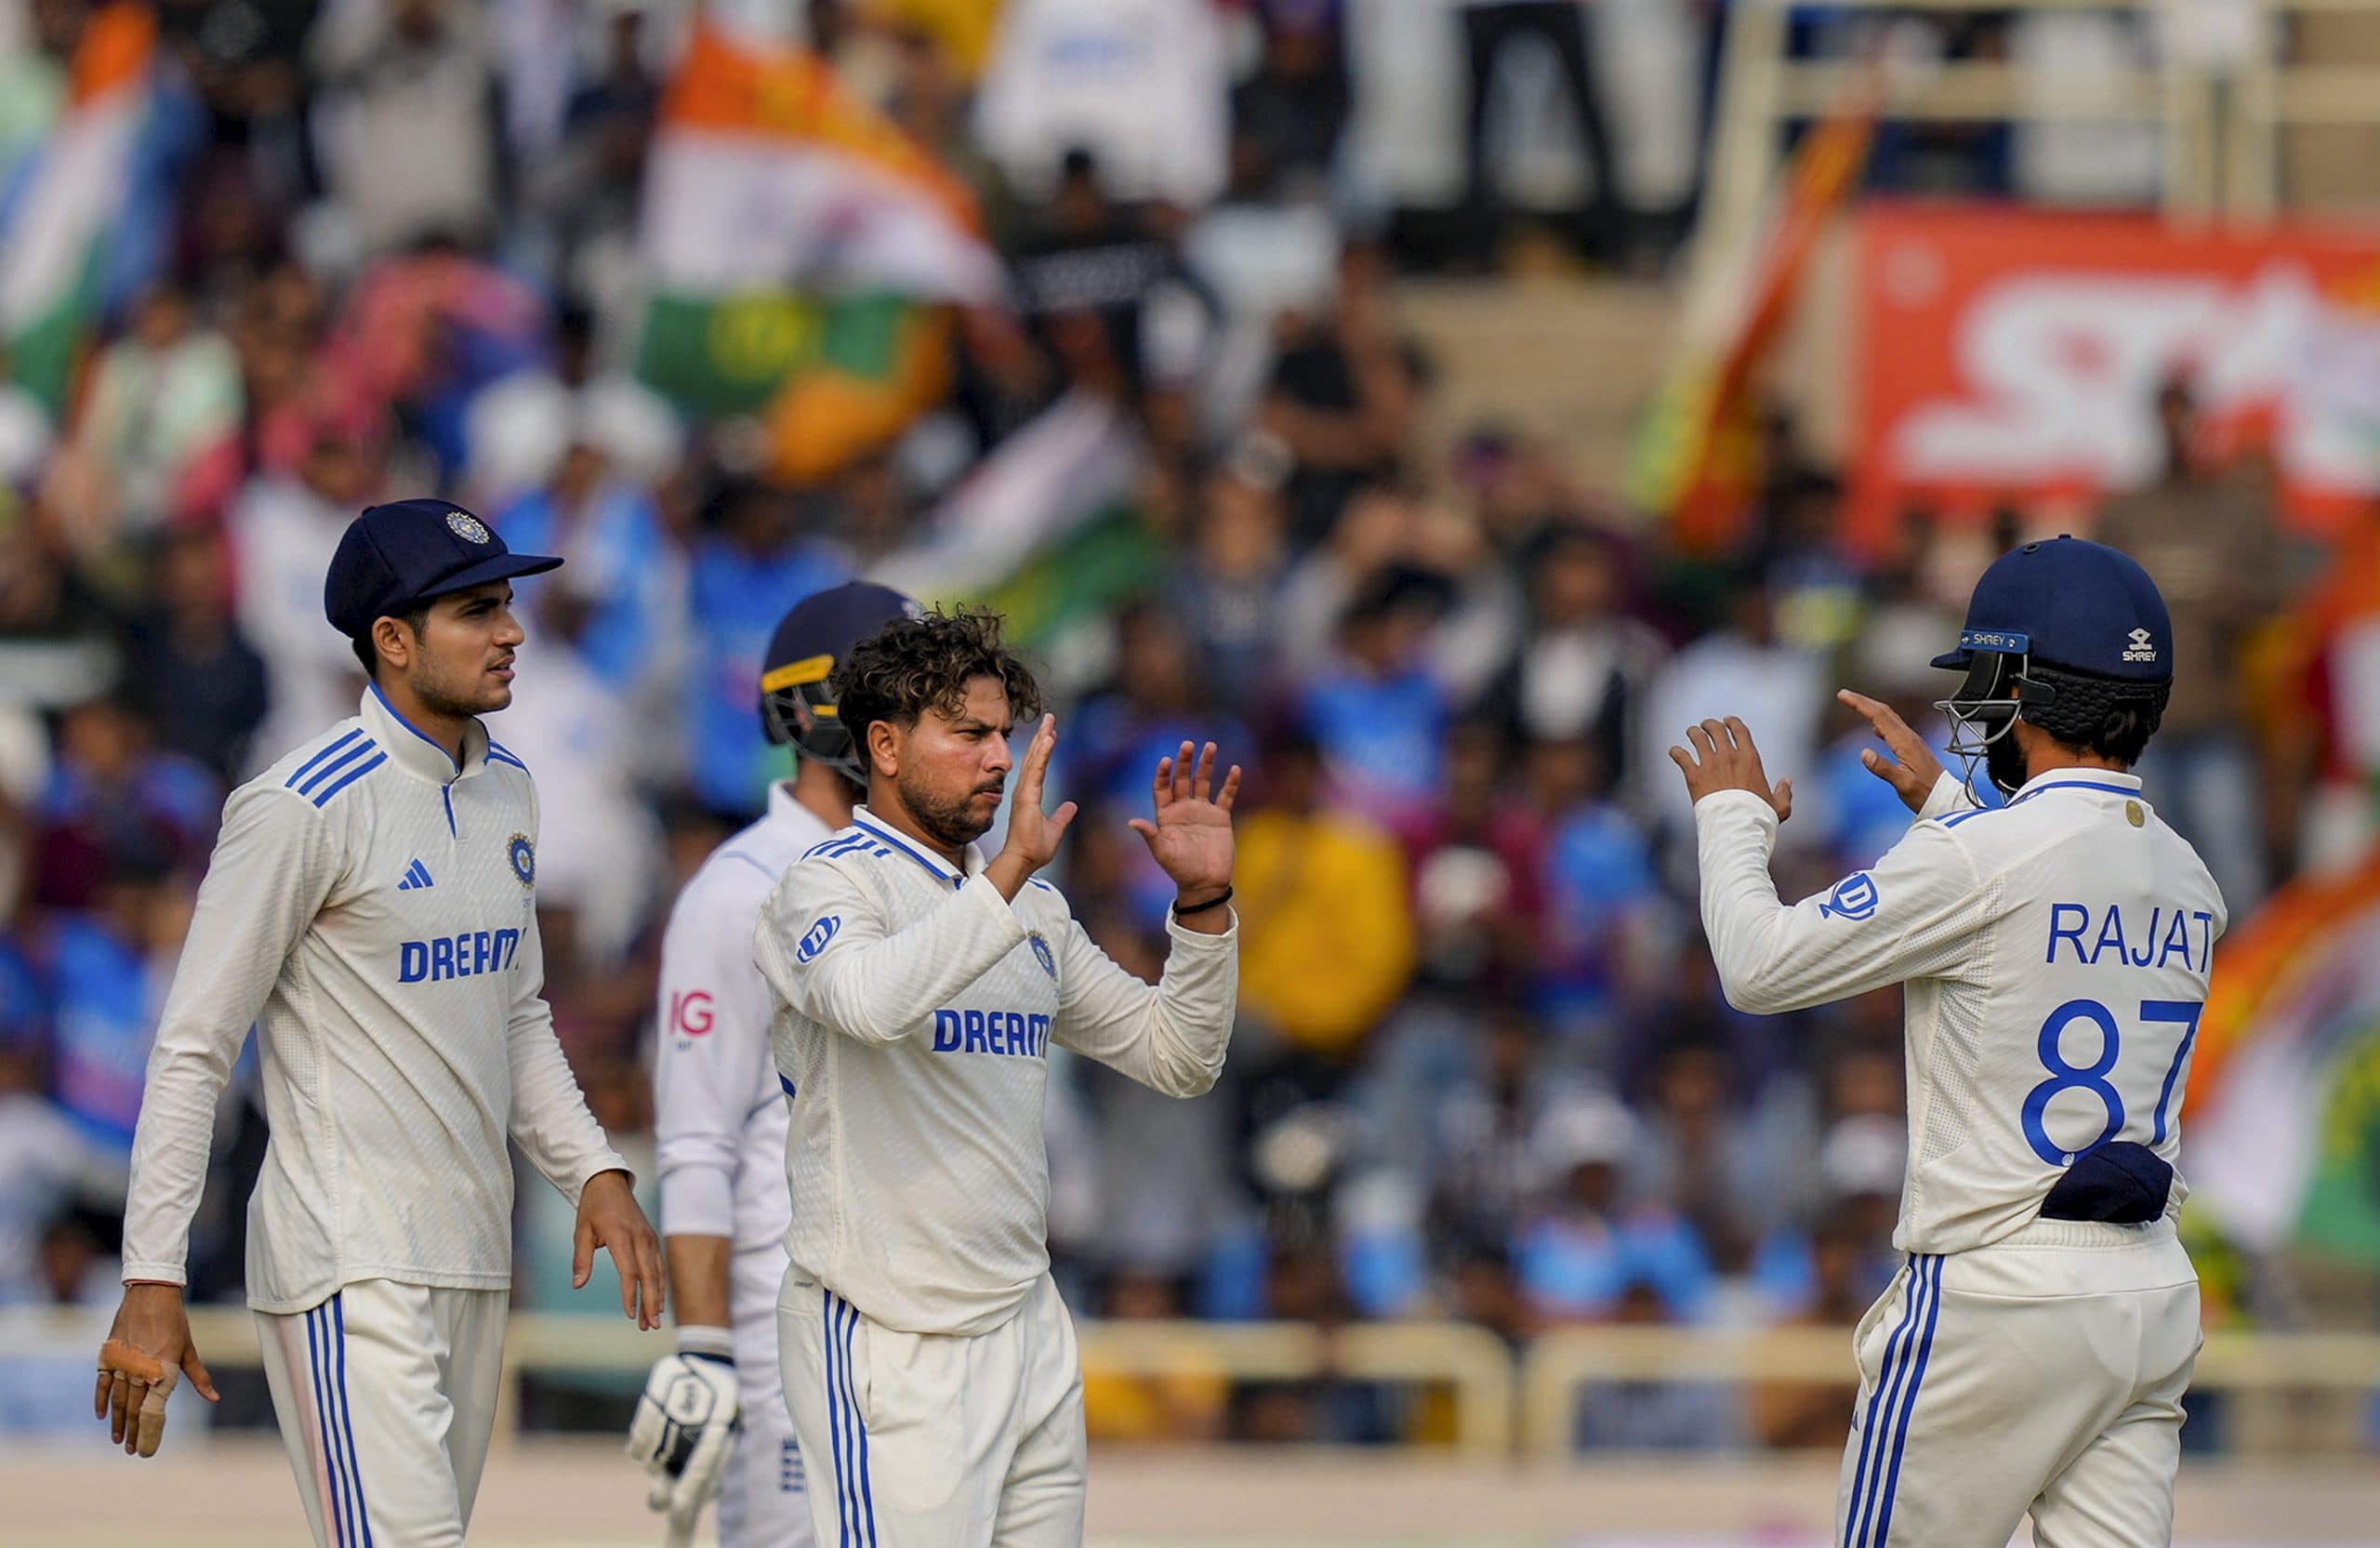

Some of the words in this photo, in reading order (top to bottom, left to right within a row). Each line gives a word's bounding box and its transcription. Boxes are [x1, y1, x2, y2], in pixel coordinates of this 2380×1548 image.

[1974, 633, 2005, 645] SHREY
[2122, 651, 2157, 662] SHREY
[398, 927, 527, 983] DREAM
[2046, 904, 2212, 973] RAJAT
[932, 1009, 1056, 1058] DREAM
[2021, 999, 2203, 1168] 87
